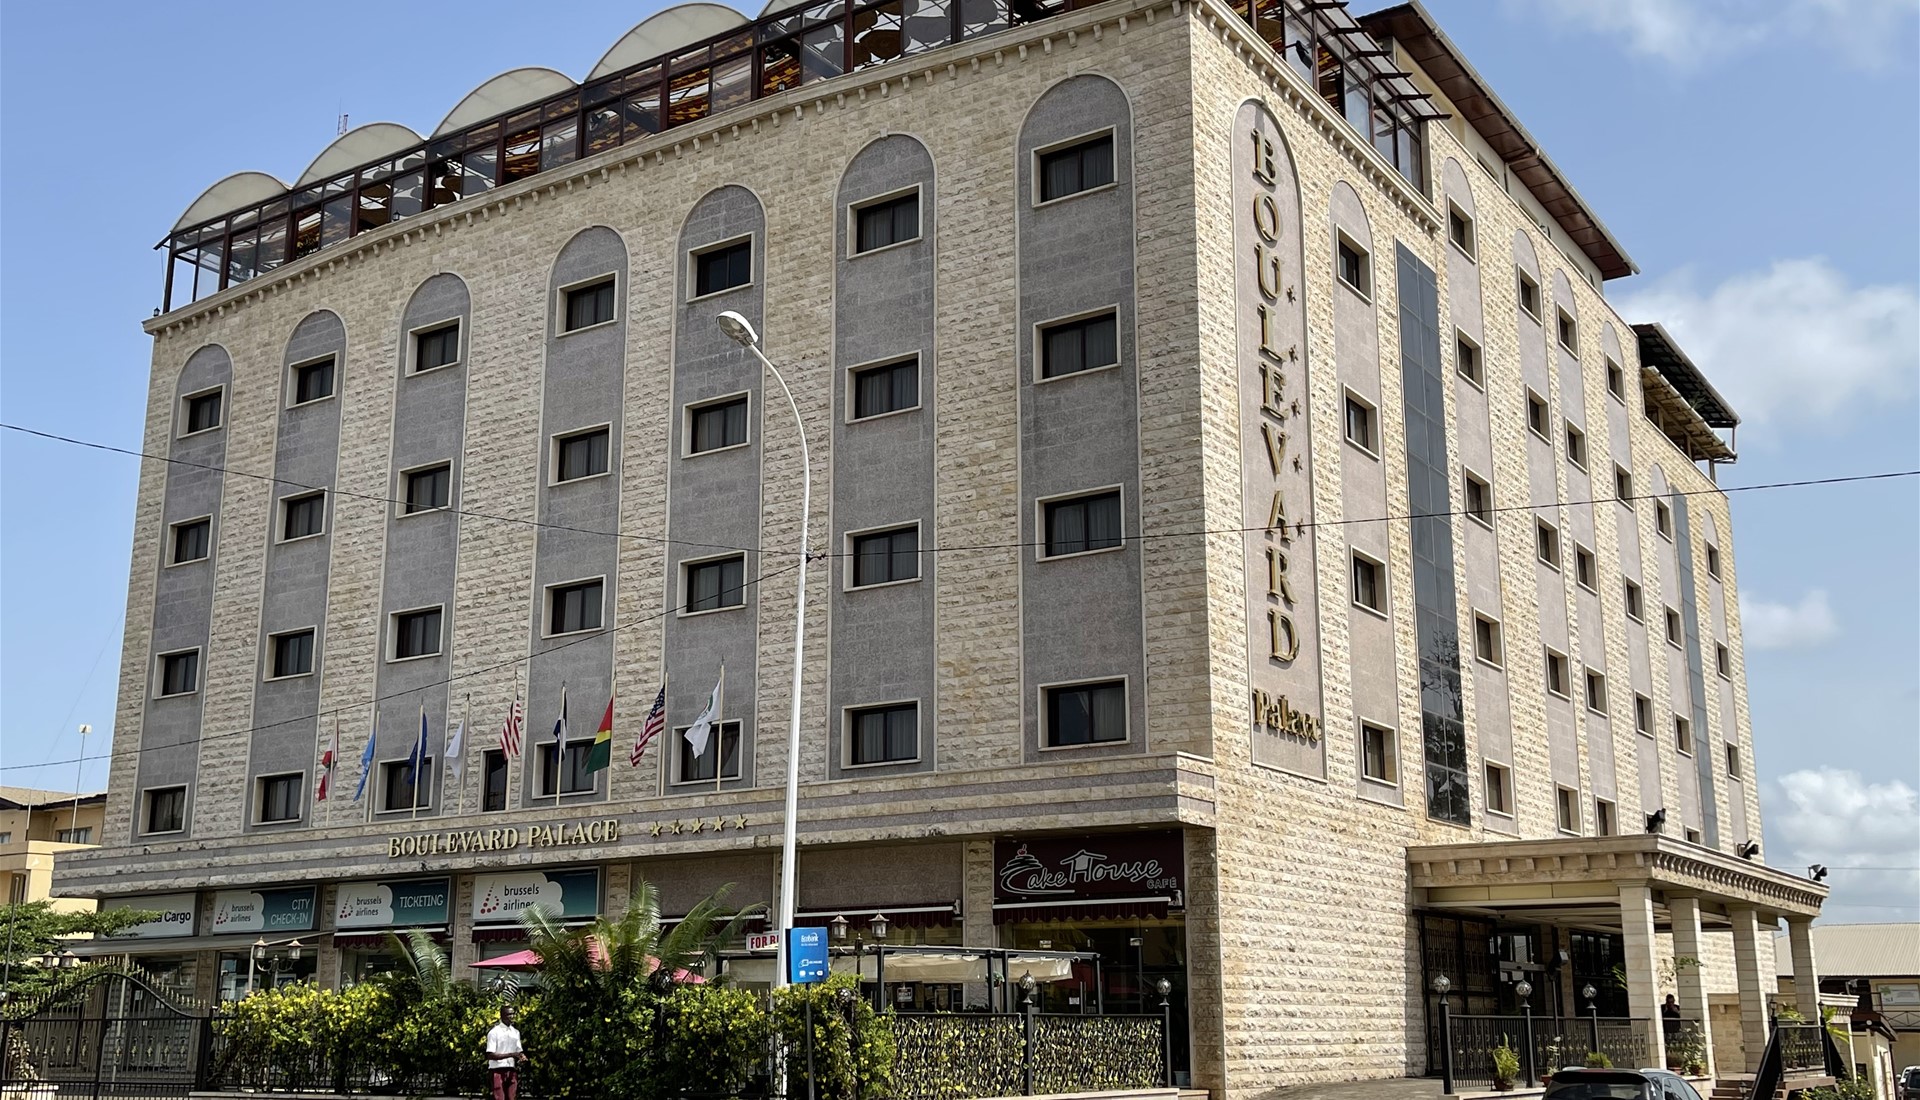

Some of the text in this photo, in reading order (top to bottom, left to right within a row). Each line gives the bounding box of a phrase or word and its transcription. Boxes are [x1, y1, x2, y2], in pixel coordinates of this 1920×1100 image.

[1251, 128, 1299, 662] BOULEVARD
[1251, 688, 1322, 742] Palace
[388, 819, 620, 858] BOULEVARD PALACE
[1000, 850, 1163, 894] Cake House
[1146, 876, 1178, 889] CAFÉ
[504, 883, 540, 896] brussels
[291, 898, 311, 911] CITY
[356, 896, 382, 906] brussels
[399, 894, 444, 908] TICKETING
[231, 903, 255, 913] brussels
[355, 907, 379, 917] airlines
[164, 911, 192, 924] Cargo
[230, 914, 251, 923] airlines
[270, 911, 309, 926] CHECK-IN
[750, 936, 768, 949] FOR
